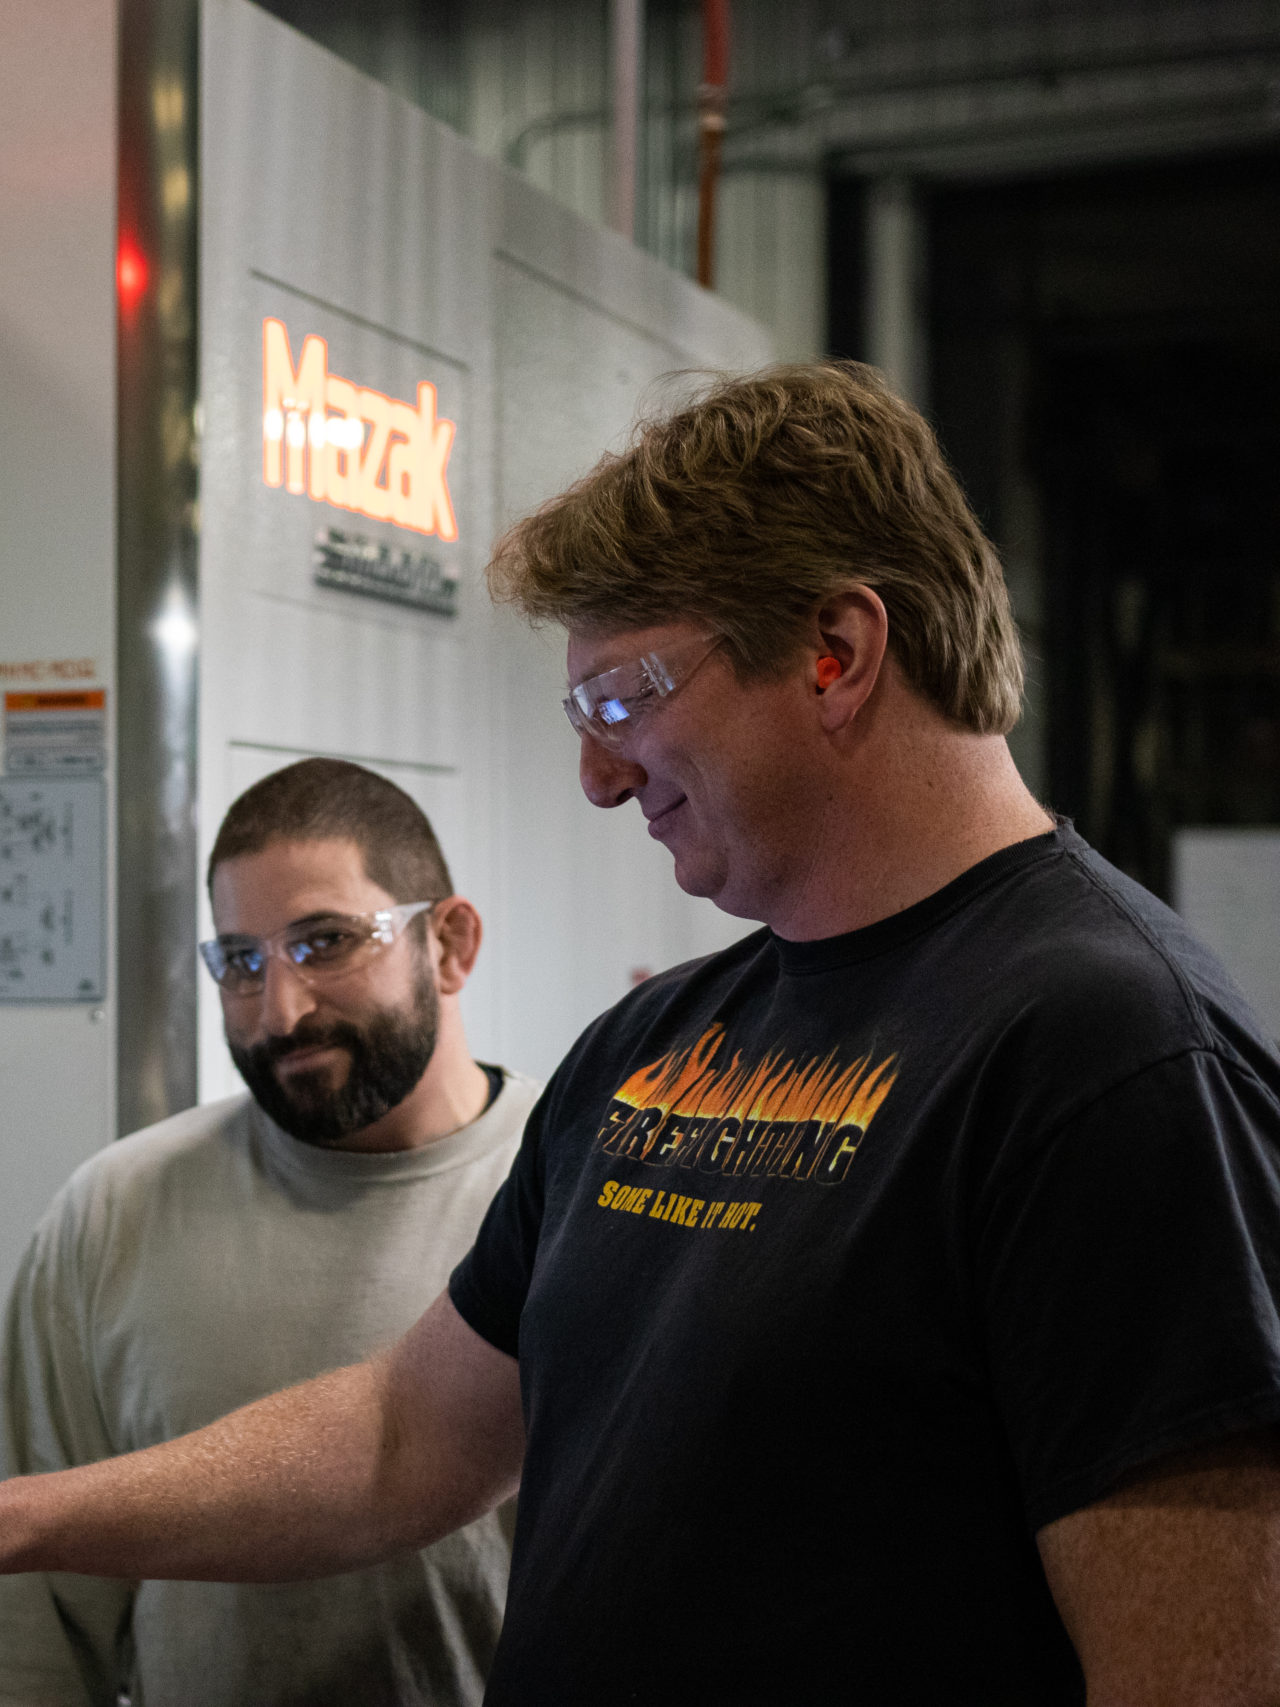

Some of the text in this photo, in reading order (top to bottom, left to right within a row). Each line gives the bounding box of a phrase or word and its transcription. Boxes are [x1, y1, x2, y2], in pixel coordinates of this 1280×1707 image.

[262, 316, 459, 543] Mazak
[597, 1180, 763, 1232] SOME LIKE IT HOT.
